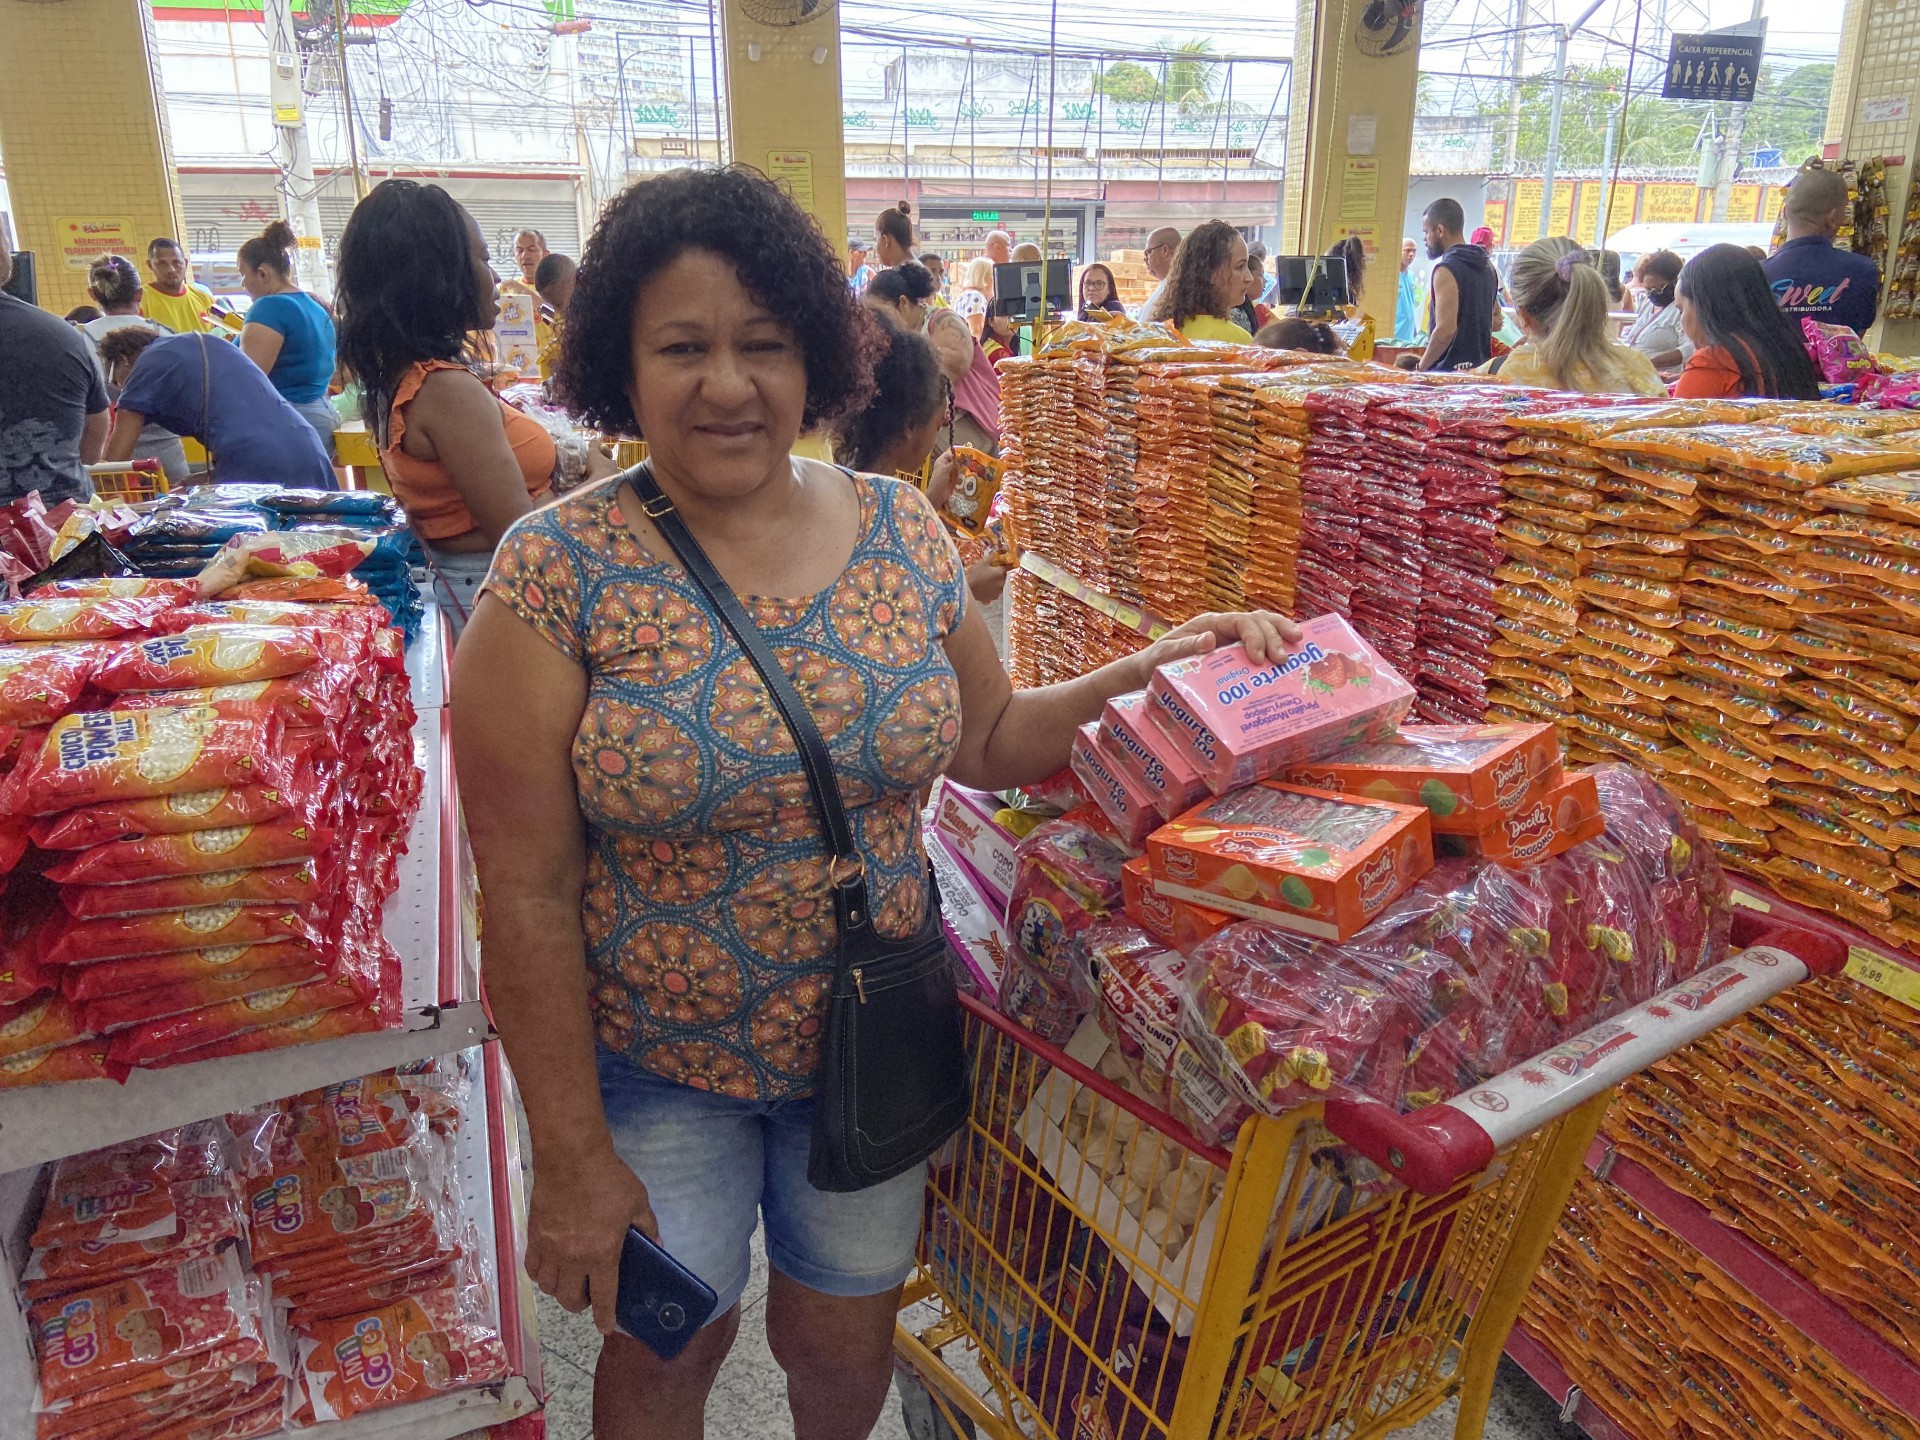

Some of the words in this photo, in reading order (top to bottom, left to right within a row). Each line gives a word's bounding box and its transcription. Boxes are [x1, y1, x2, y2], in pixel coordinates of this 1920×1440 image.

[1679, 45, 1701, 54] CAIXA
[1703, 46, 1753, 57] PREFERENCIAL
[1780, 305, 1833, 313] ISTRIBUIDORA
[1216, 666, 1250, 688] Original
[1250, 641, 1324, 689] yogurte
[1217, 680, 1252, 707] 100
[1275, 696, 1302, 710] Chewy
[1160, 691, 1215, 746] yogurte
[1240, 710, 1288, 732] Mastigável
[1243, 706, 1275, 721] Lollipop
[1287, 700, 1319, 715] Pirulito
[83, 710, 117, 762] POWER
[117, 717, 137, 743] BALL
[60, 729, 87, 771] CHOCO
[1112, 723, 1165, 775] yogurte
[1192, 735, 1217, 762] 100
[1082, 748, 1126, 799] yogurte
[1143, 766, 1167, 790] 100
[1496, 758, 1525, 791] Docile
[1109, 790, 1128, 813] 100
[1509, 811, 1547, 837] Docile
[992, 848, 1014, 873] COPO
[1166, 852, 1193, 867] Docile
[1361, 855, 1395, 887] Docile
[1143, 888, 1170, 916] Docile
[1859, 965, 1883, 983] 9,98
[273, 1175, 304, 1233] Cores
[61, 1299, 98, 1367] Cores
[335, 1335, 364, 1382] Mil
[354, 1317, 394, 1388] Cores
